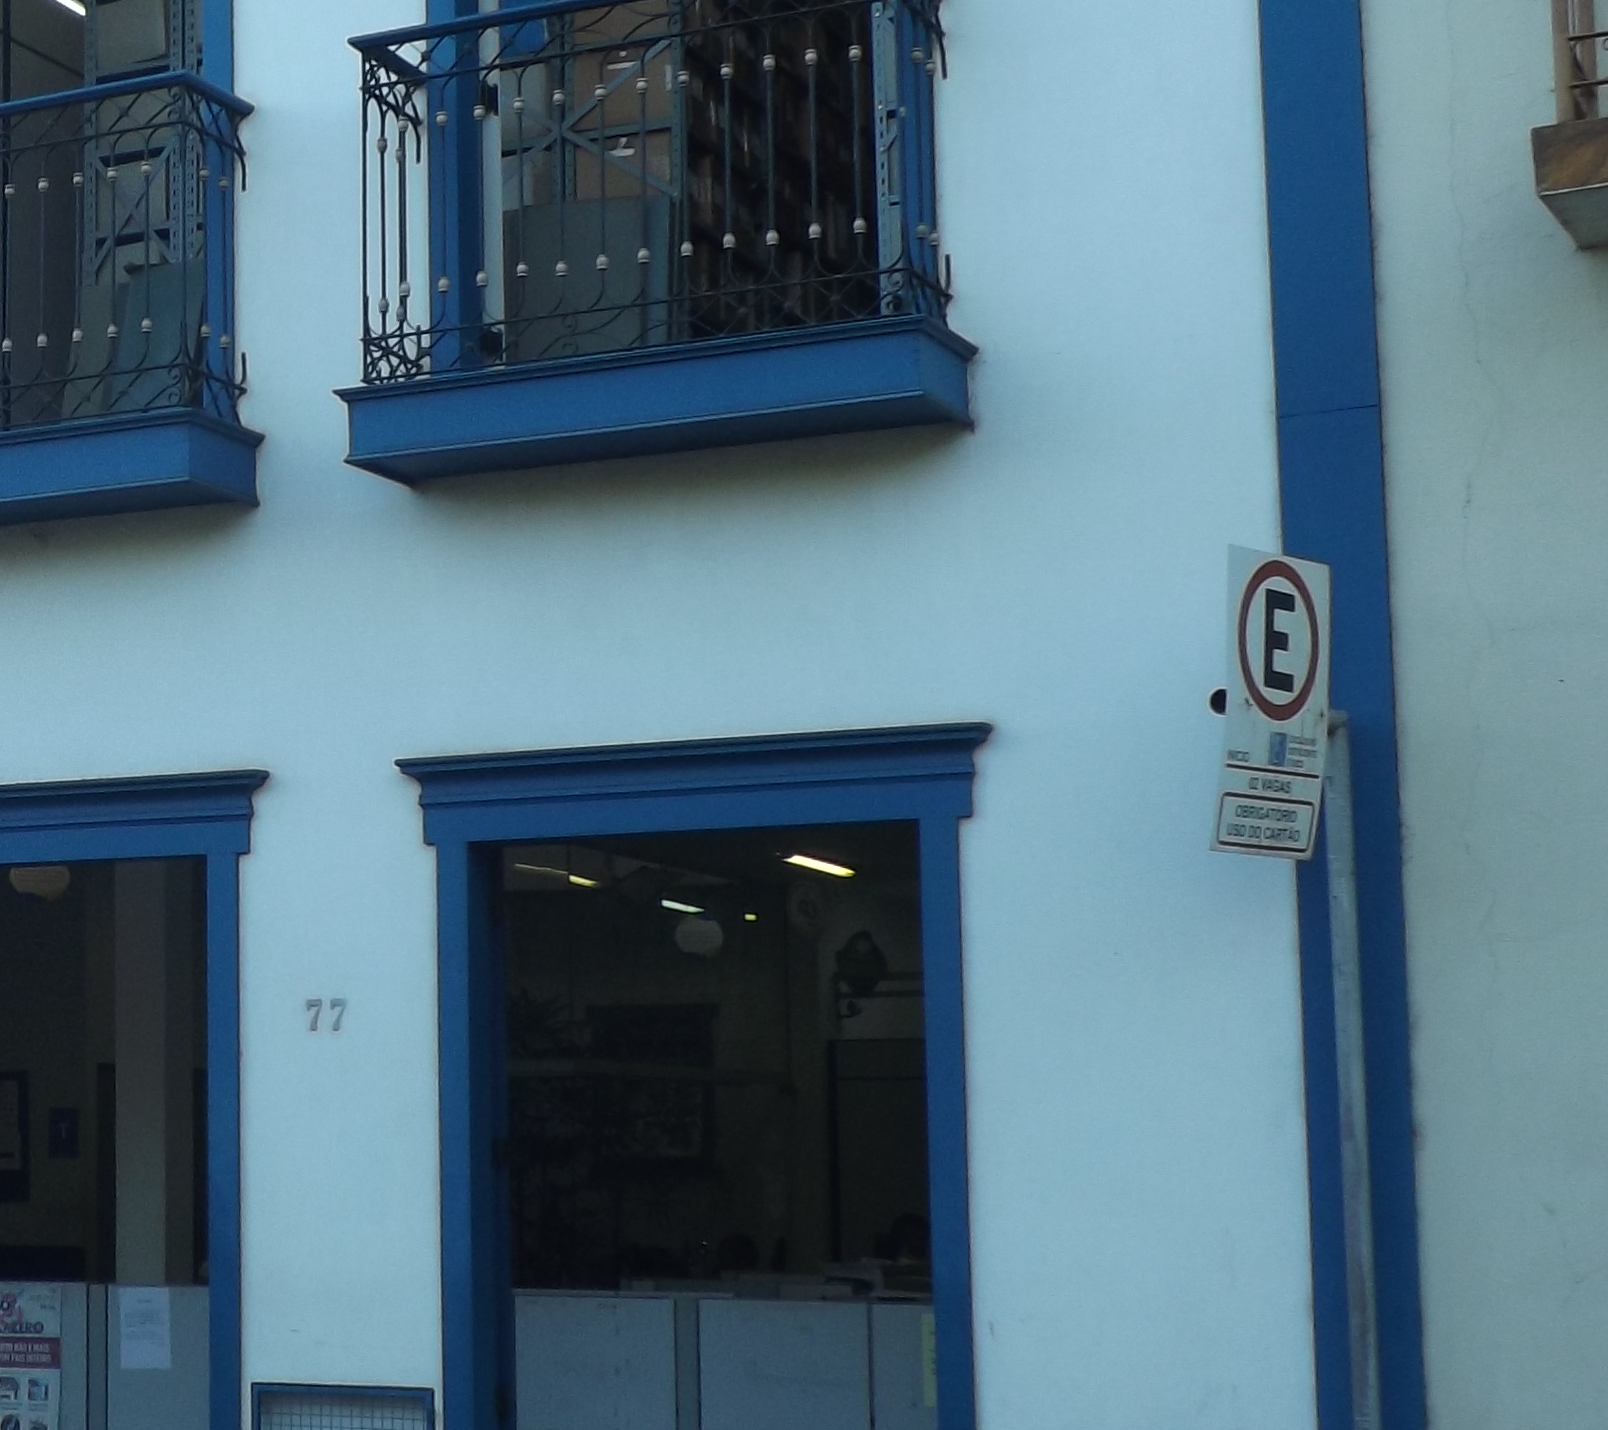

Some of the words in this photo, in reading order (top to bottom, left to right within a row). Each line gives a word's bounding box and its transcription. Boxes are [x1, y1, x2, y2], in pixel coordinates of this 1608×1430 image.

[1263, 587, 1295, 693] E
[1261, 778, 1292, 794] VAGAS
[1227, 823, 1247, 837] USO
[1248, 825, 1262, 839] DO
[306, 998, 346, 1032] 77
